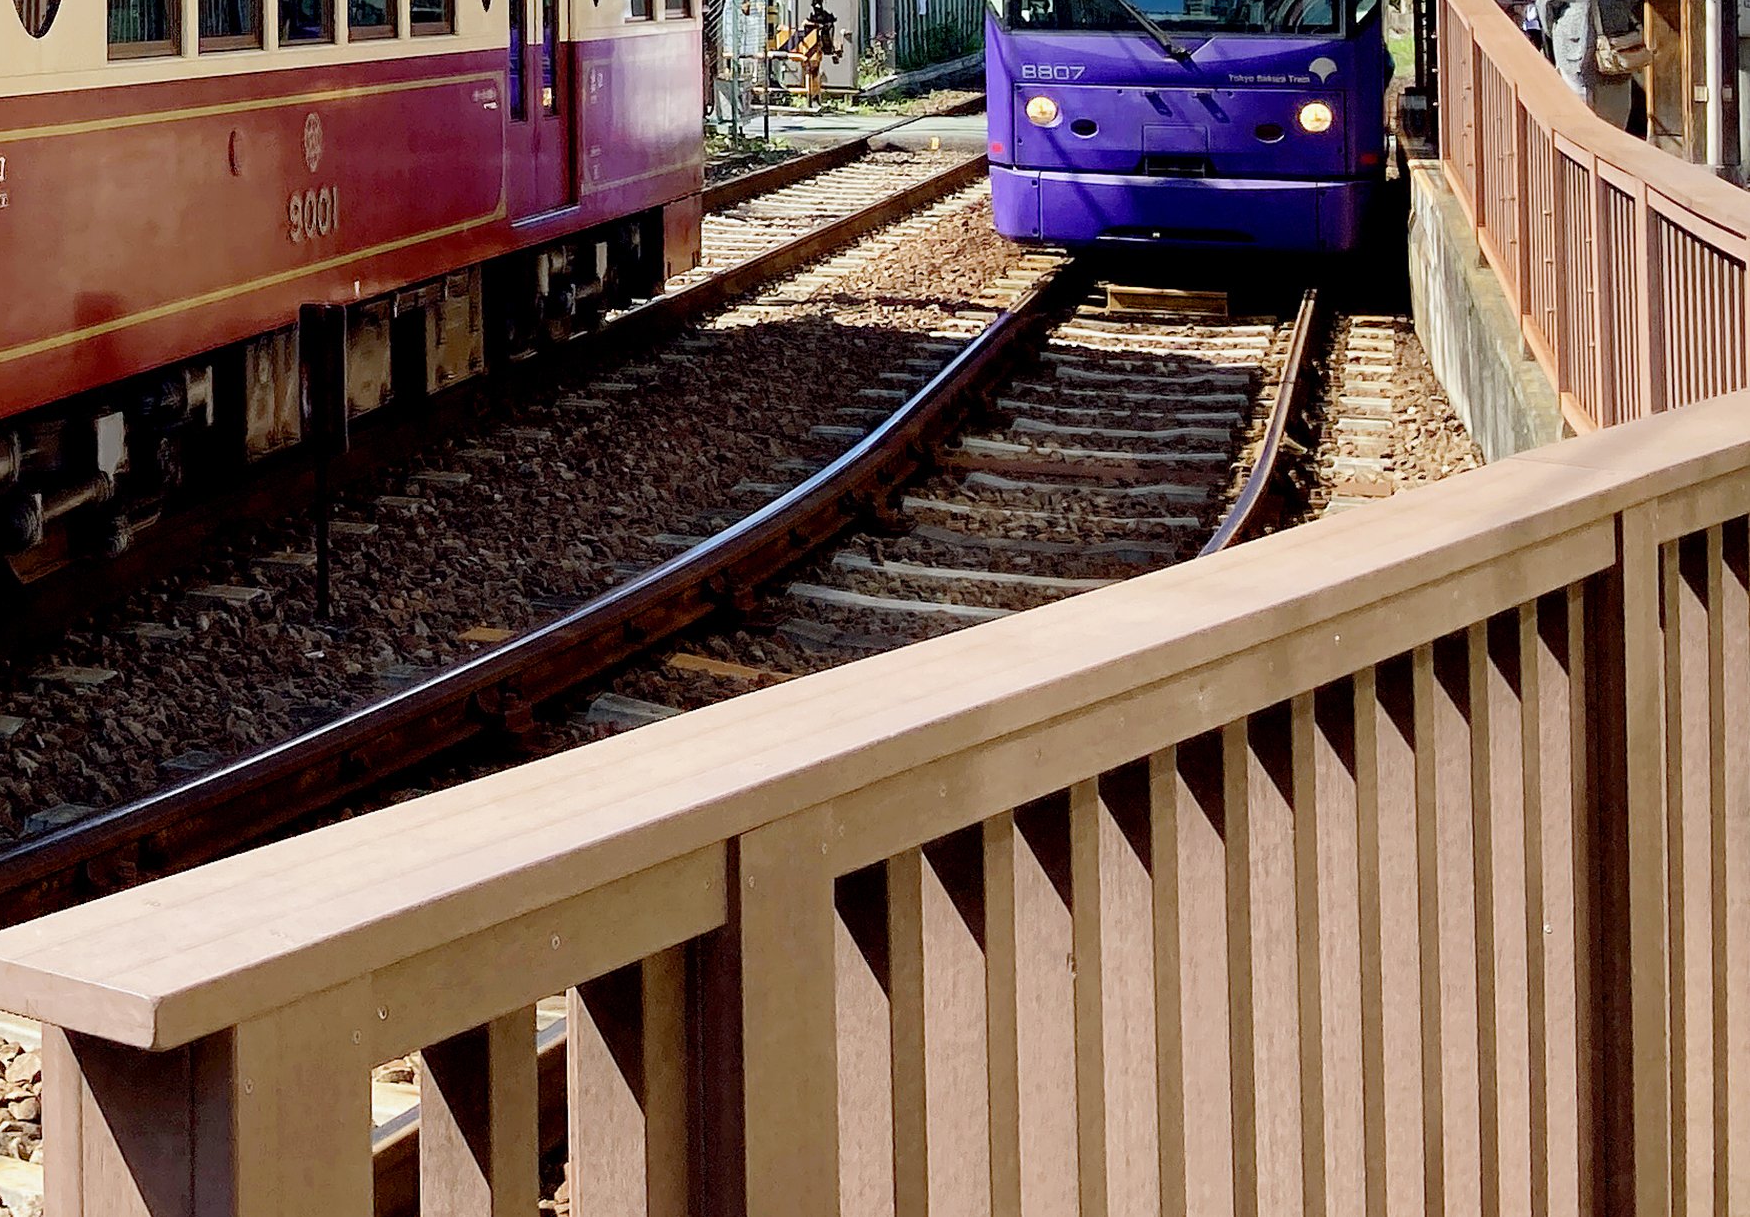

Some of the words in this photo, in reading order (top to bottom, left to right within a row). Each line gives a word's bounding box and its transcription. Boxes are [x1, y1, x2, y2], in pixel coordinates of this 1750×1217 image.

[1021, 64, 1086, 81] 8807
[1228, 73, 1255, 84] Tokyo
[288, 184, 339, 243] 9001
